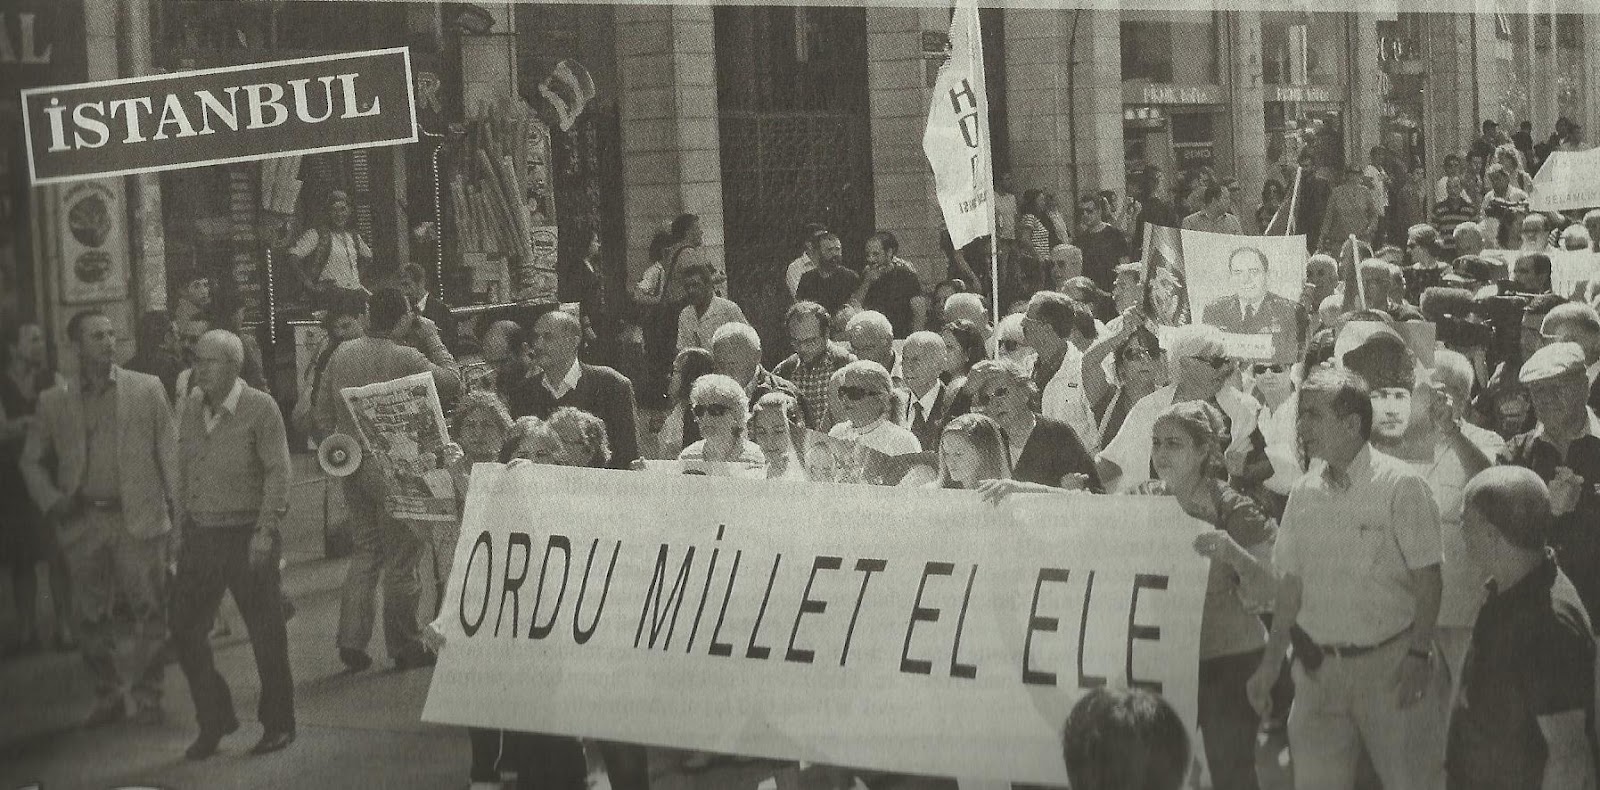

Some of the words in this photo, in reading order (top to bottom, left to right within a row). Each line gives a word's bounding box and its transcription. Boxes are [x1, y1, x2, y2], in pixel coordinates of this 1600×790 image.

[459, 530, 622, 645] ORDU
[633, 524, 888, 666] MİLLET
[900, 561, 978, 678] EL
[1022, 567, 1169, 693] ELE
